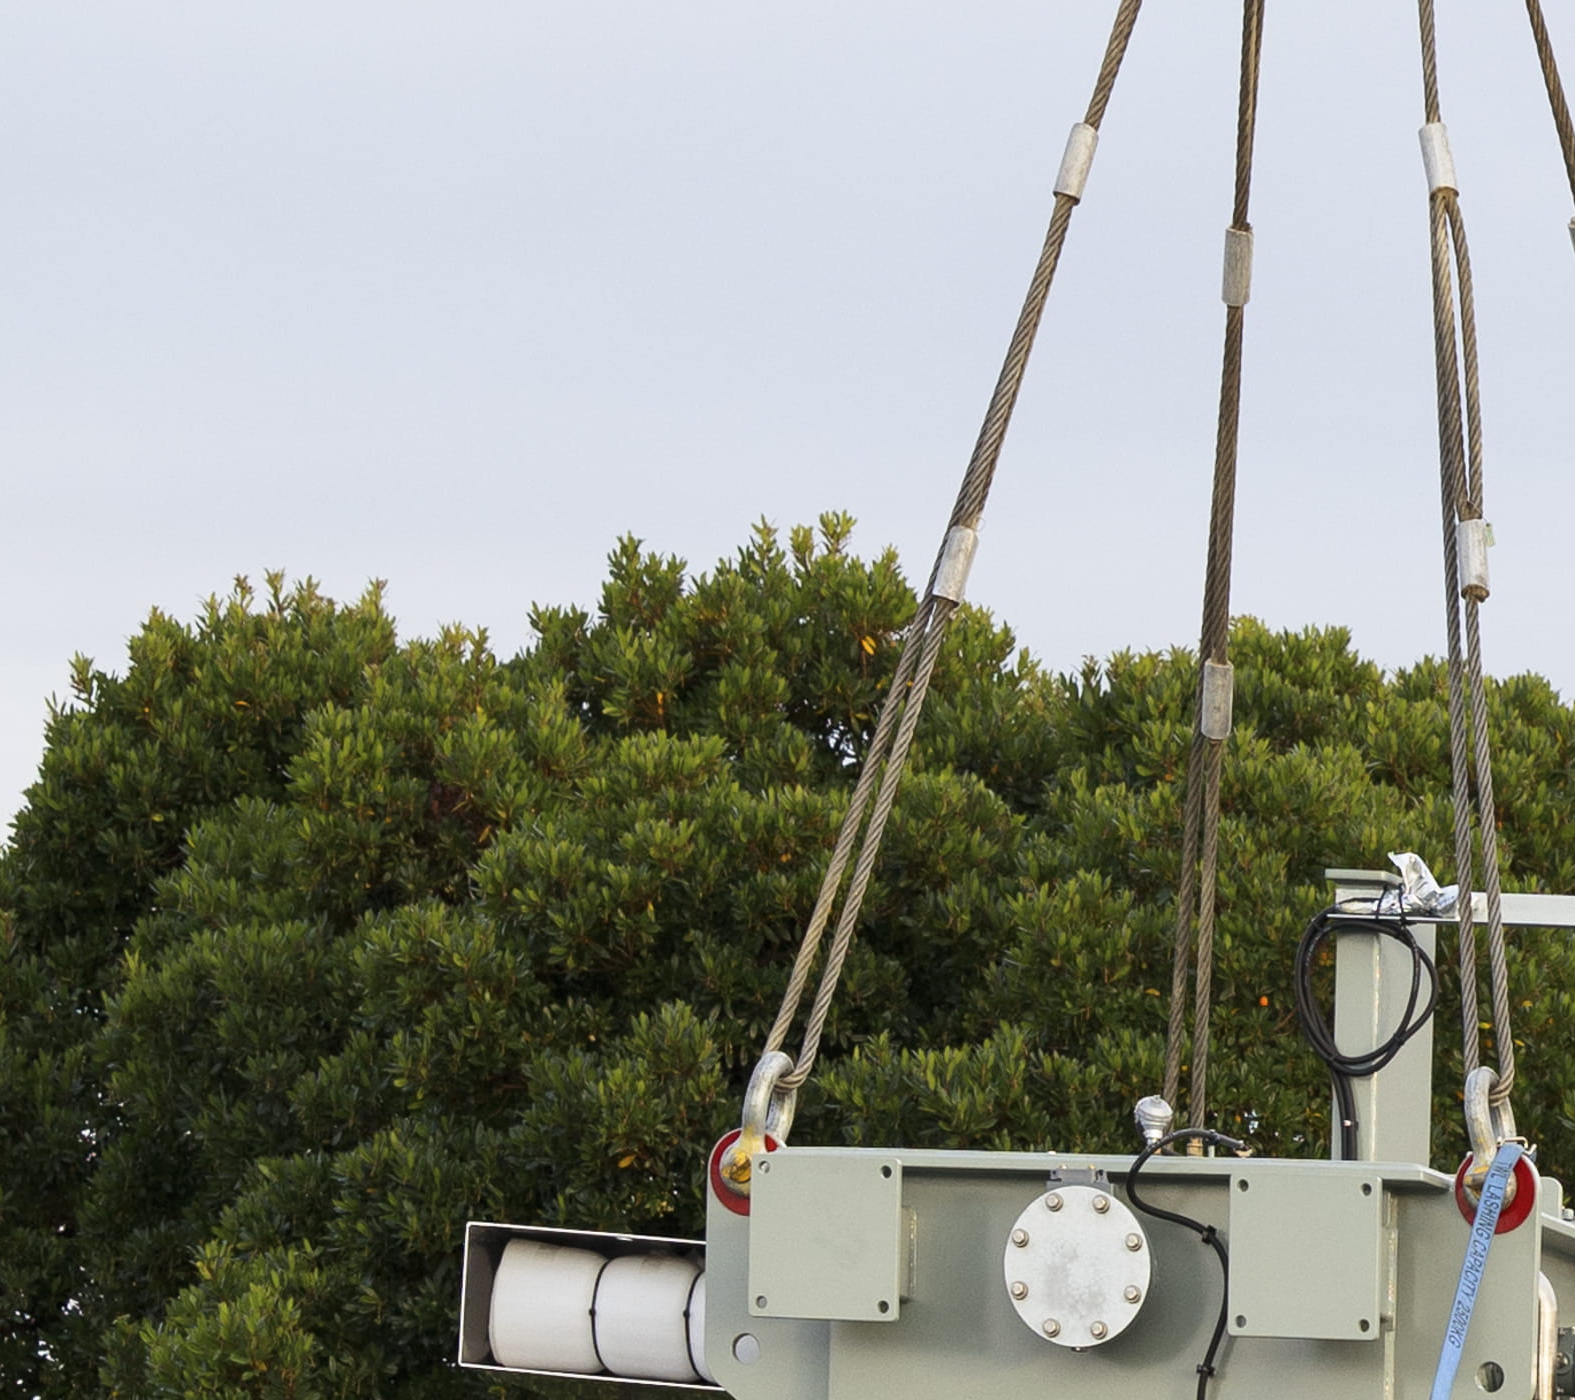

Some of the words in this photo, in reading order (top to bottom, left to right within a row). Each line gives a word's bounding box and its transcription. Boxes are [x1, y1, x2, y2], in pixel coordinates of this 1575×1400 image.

[1475, 1184, 1504, 1241] LASHING
[1460, 1239, 1489, 1301] CAPACITY
[1448, 1300, 1472, 1349] 2500KG
